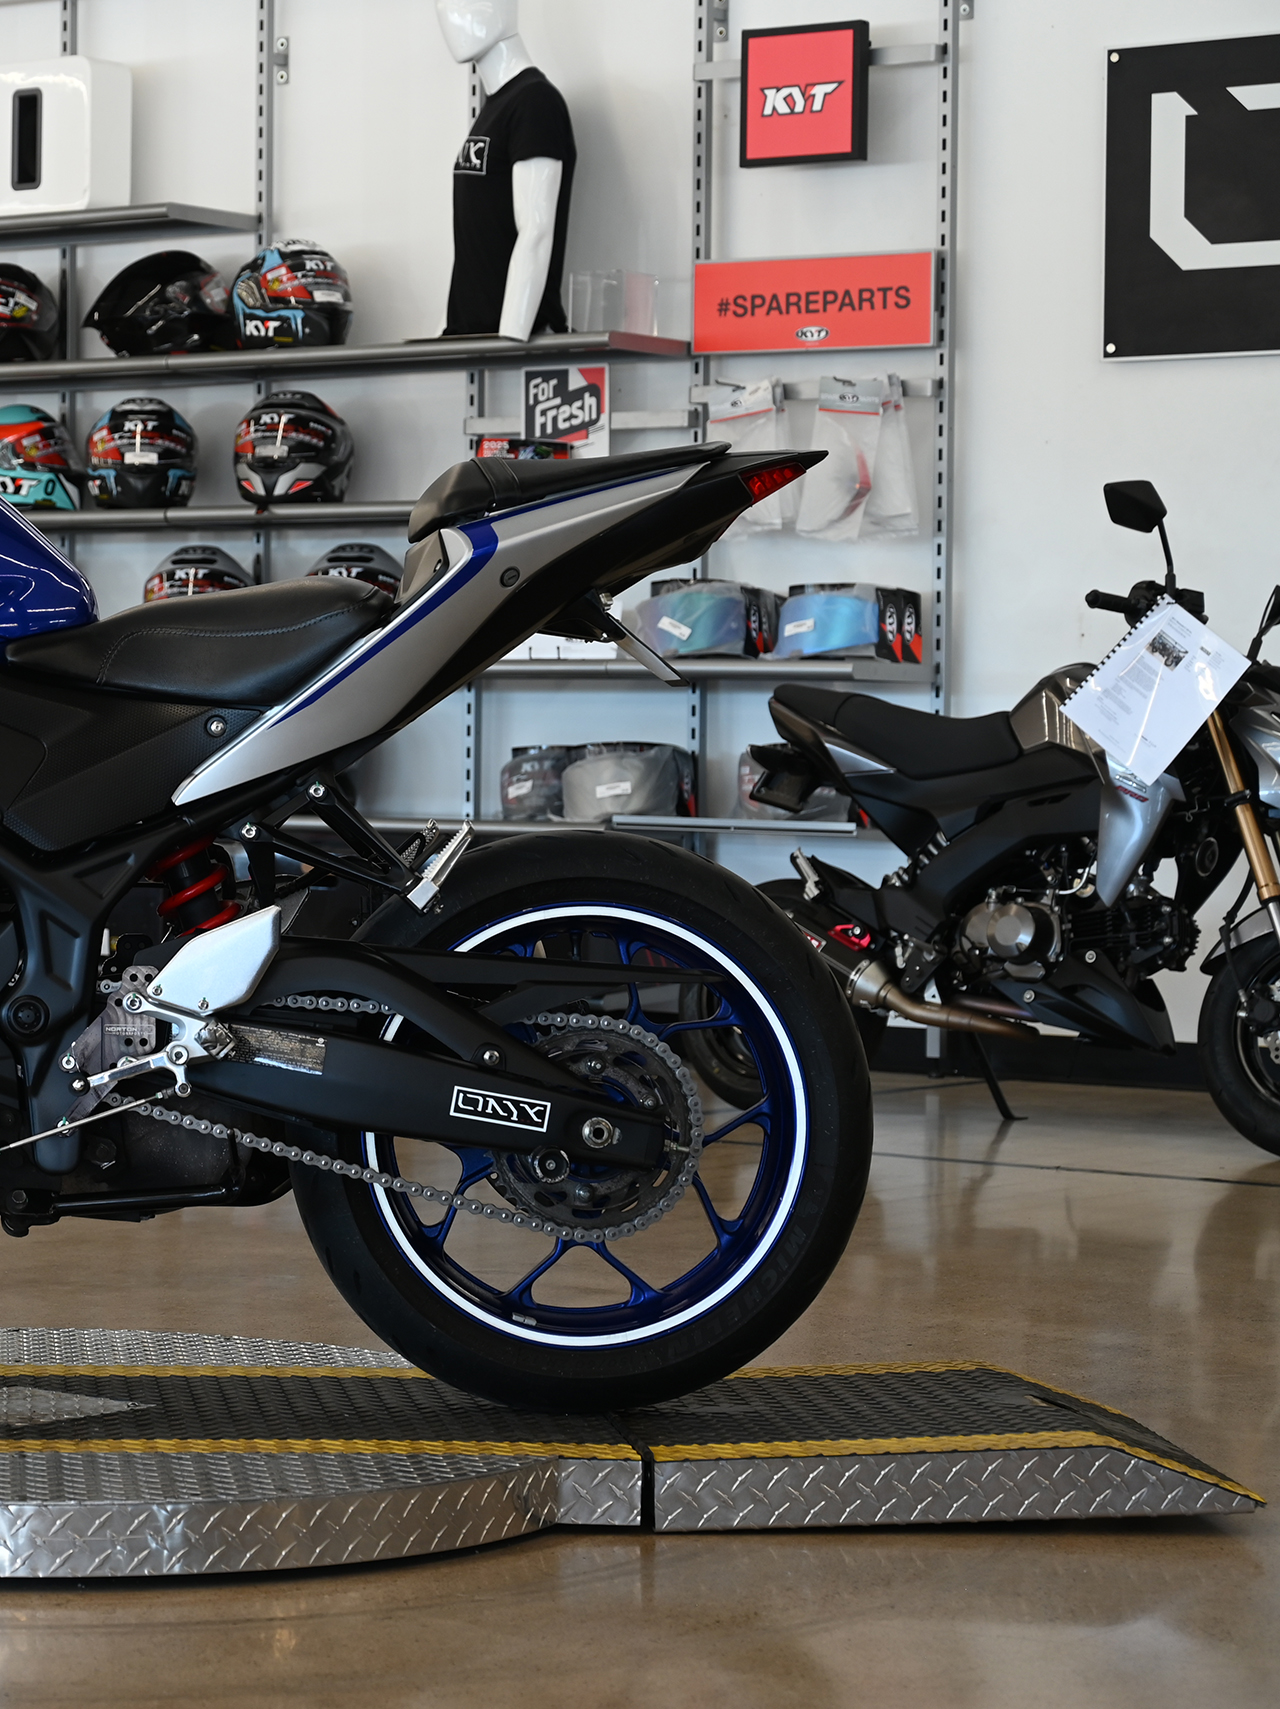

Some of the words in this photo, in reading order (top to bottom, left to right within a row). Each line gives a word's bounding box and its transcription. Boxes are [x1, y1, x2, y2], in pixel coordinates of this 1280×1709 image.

[761, 81, 844, 117] KYT
[304, 260, 334, 270] KYT
[717, 286, 911, 318] #SPAREPARTS
[245, 320, 281, 337] KYT
[796, 329, 829, 339] KYT
[529, 377, 558, 406] For
[535, 391, 597, 438] Fresh
[457, 1092, 544, 1123] ONYX
